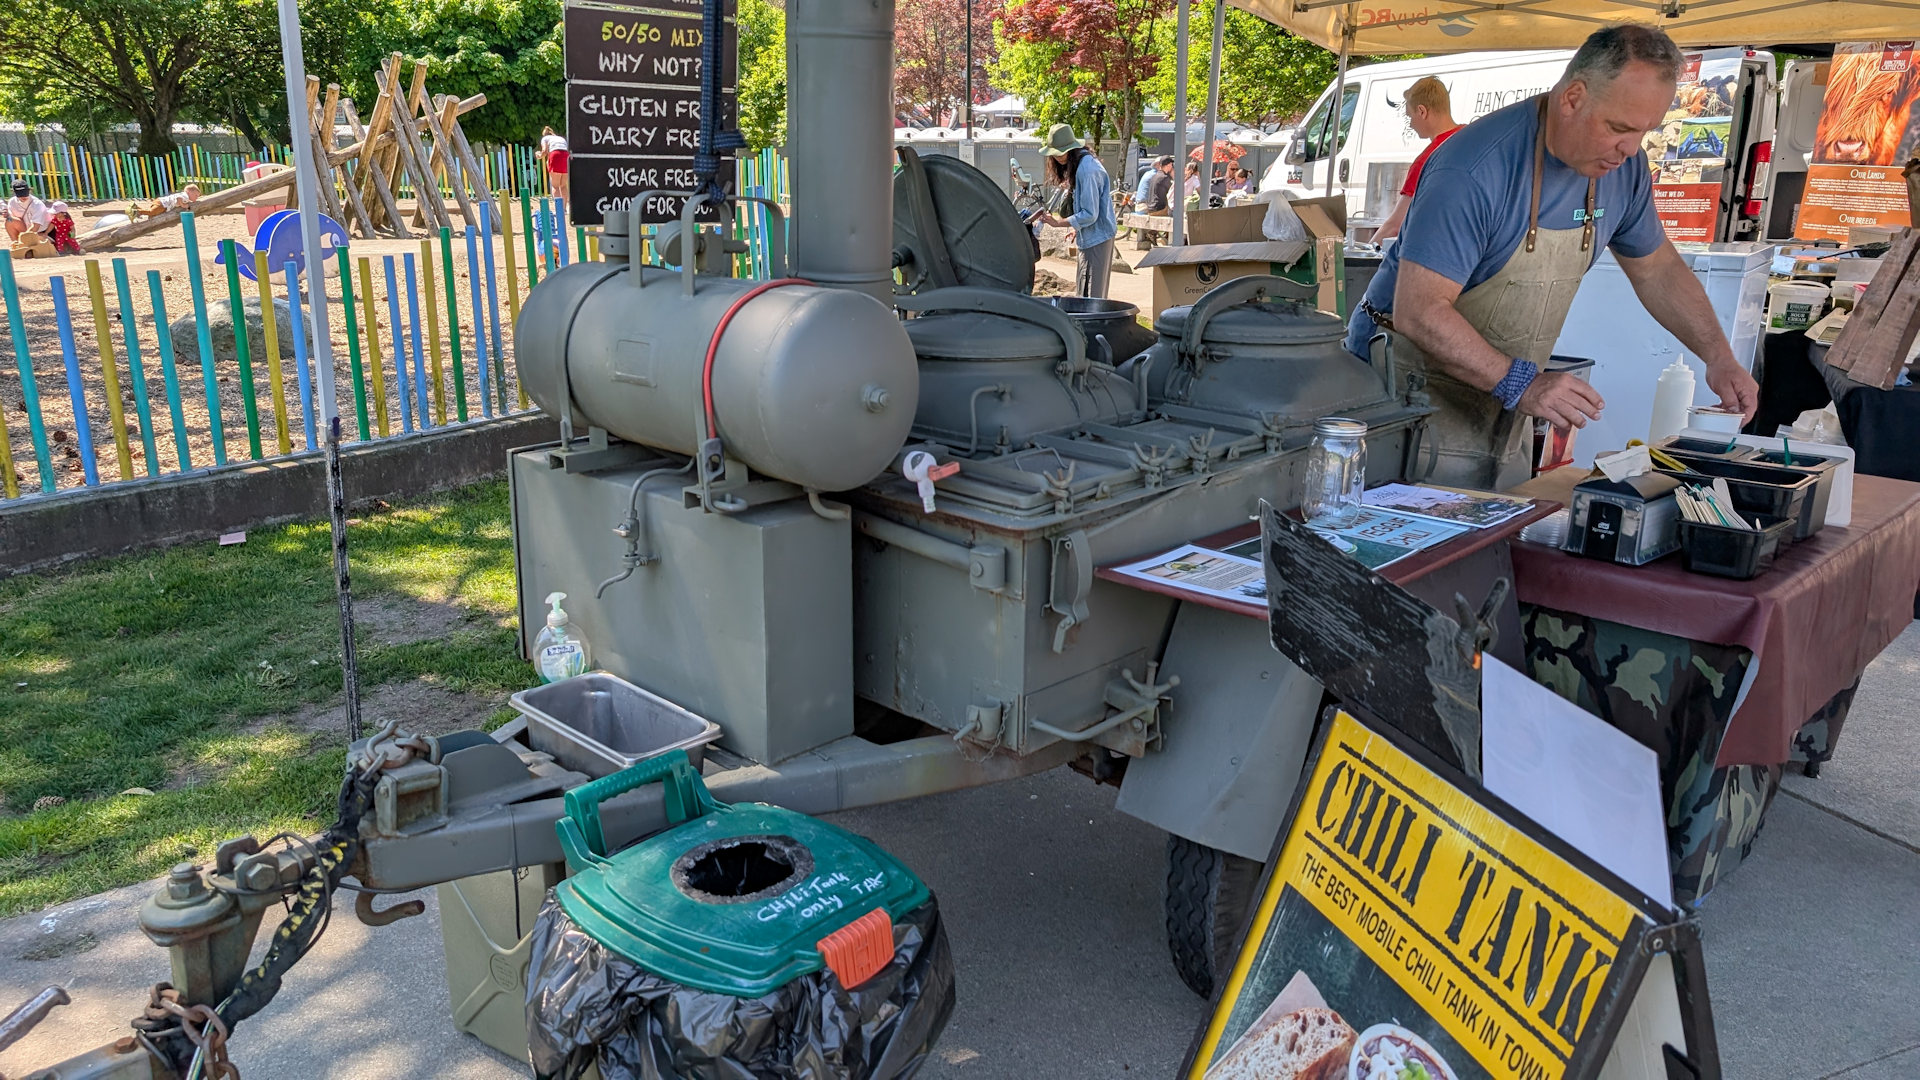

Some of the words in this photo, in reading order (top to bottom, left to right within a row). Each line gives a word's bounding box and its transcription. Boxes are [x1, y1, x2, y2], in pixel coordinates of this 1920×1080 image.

[602, 21, 661, 43] 50/50
[599, 52, 644, 73] WHY
[654, 57, 702, 78] NOT?
[579, 95, 667, 117] GLUTEN
[589, 126, 658, 148] DAIRY
[666, 128, 701, 149] FRE
[607, 168, 659, 188] SUGAR
[596, 196, 632, 214] GOO
[646, 197, 676, 216] FOR
[1315, 759, 1443, 908] CHILI
[1444, 850, 1613, 1043] TANK
[1301, 852, 1328, 889] THE
[1324, 873, 1360, 916] BEST
[1355, 901, 1408, 962] MOBILE
[1404, 946, 1444, 996] CHILI
[1441, 979, 1483, 1034] TANK
[1478, 1015, 1502, 1051] IN
